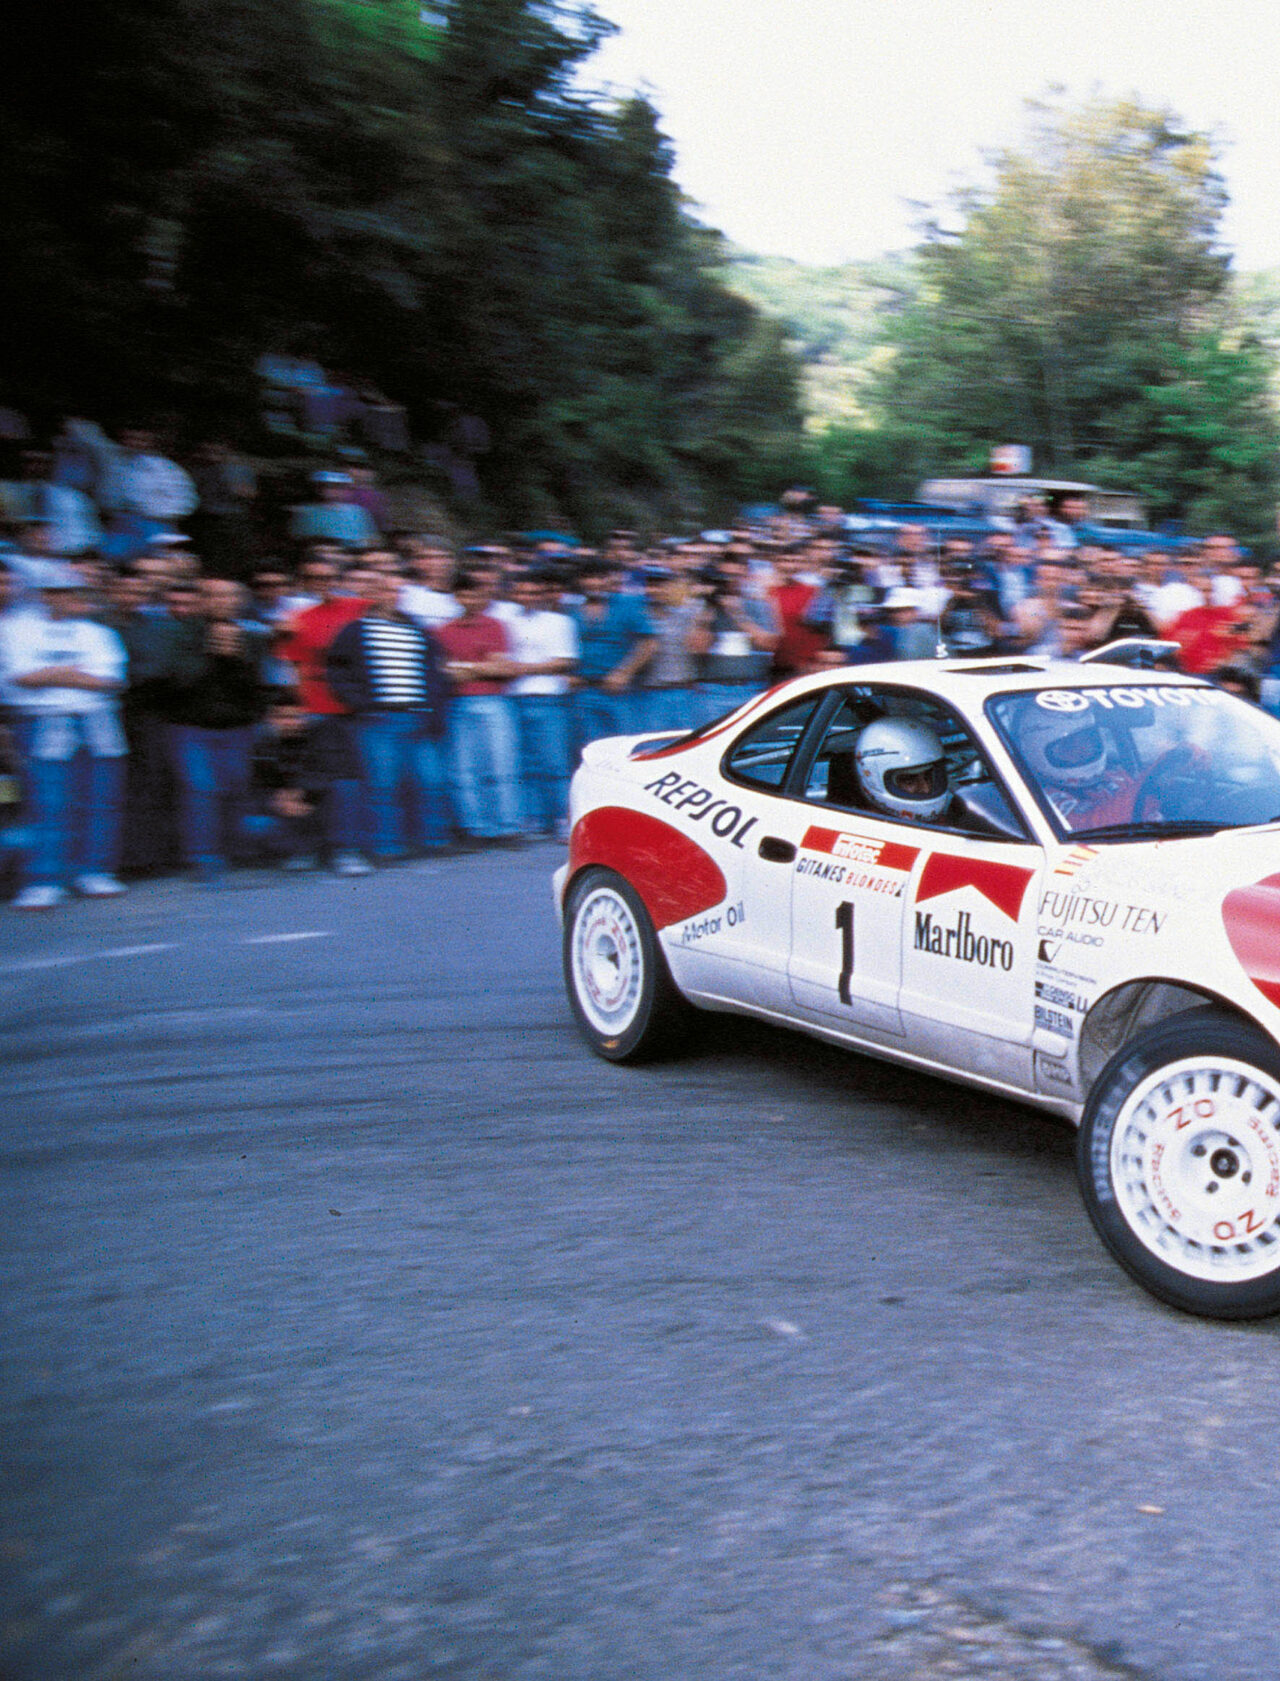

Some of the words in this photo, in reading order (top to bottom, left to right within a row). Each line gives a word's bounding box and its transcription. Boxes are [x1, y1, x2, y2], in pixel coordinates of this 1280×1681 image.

[643, 770, 759, 850] REPSOL
[796, 857, 847, 883] GITANES
[1037, 924, 1064, 939] CAR
[1065, 931, 1105, 948] AUDIO
[1038, 890, 1119, 927] FUJITSU
[1121, 904, 1168, 935] TEN
[835, 900, 855, 1007] 1
[914, 910, 1014, 972] Marlboro
